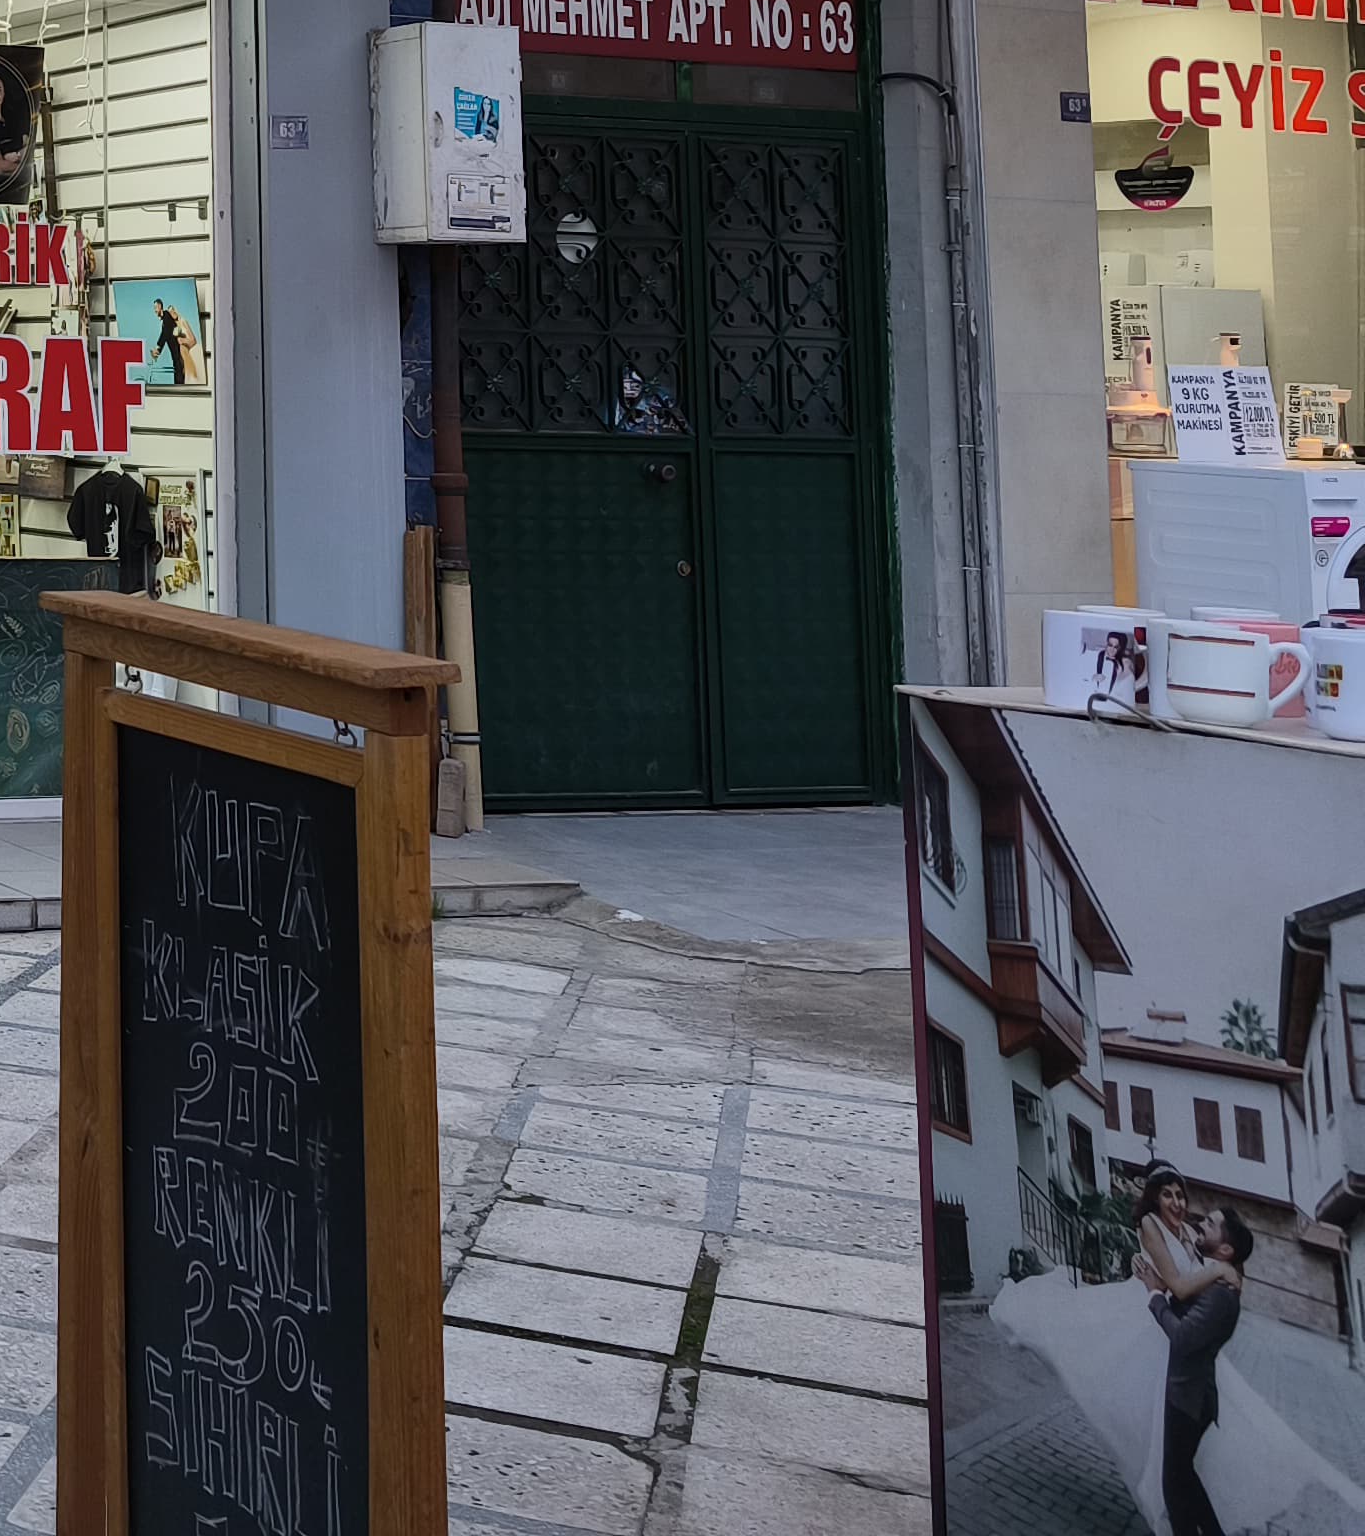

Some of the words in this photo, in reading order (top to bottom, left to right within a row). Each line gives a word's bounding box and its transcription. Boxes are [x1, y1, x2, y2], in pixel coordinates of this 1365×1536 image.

[820, 0, 855, 55] 63
[1148, 48, 1329, 140] ÇEYİZ
[1110, 298, 1124, 361] KAMPANYA
[1171, 375, 1215, 385] KAMPANYA
[1181, 387, 1190, 400] 9
[1193, 387, 1210, 401] KG
[1288, 384, 1300, 413] GETİR
[1175, 402, 1221, 415] KURUTMA
[1177, 416, 1223, 431] MAKİNESİ
[1222, 369, 1248, 456] KAMPANYA
[170, 773, 332, 952] KUPA
[141, 918, 320, 1083] KLASİK
